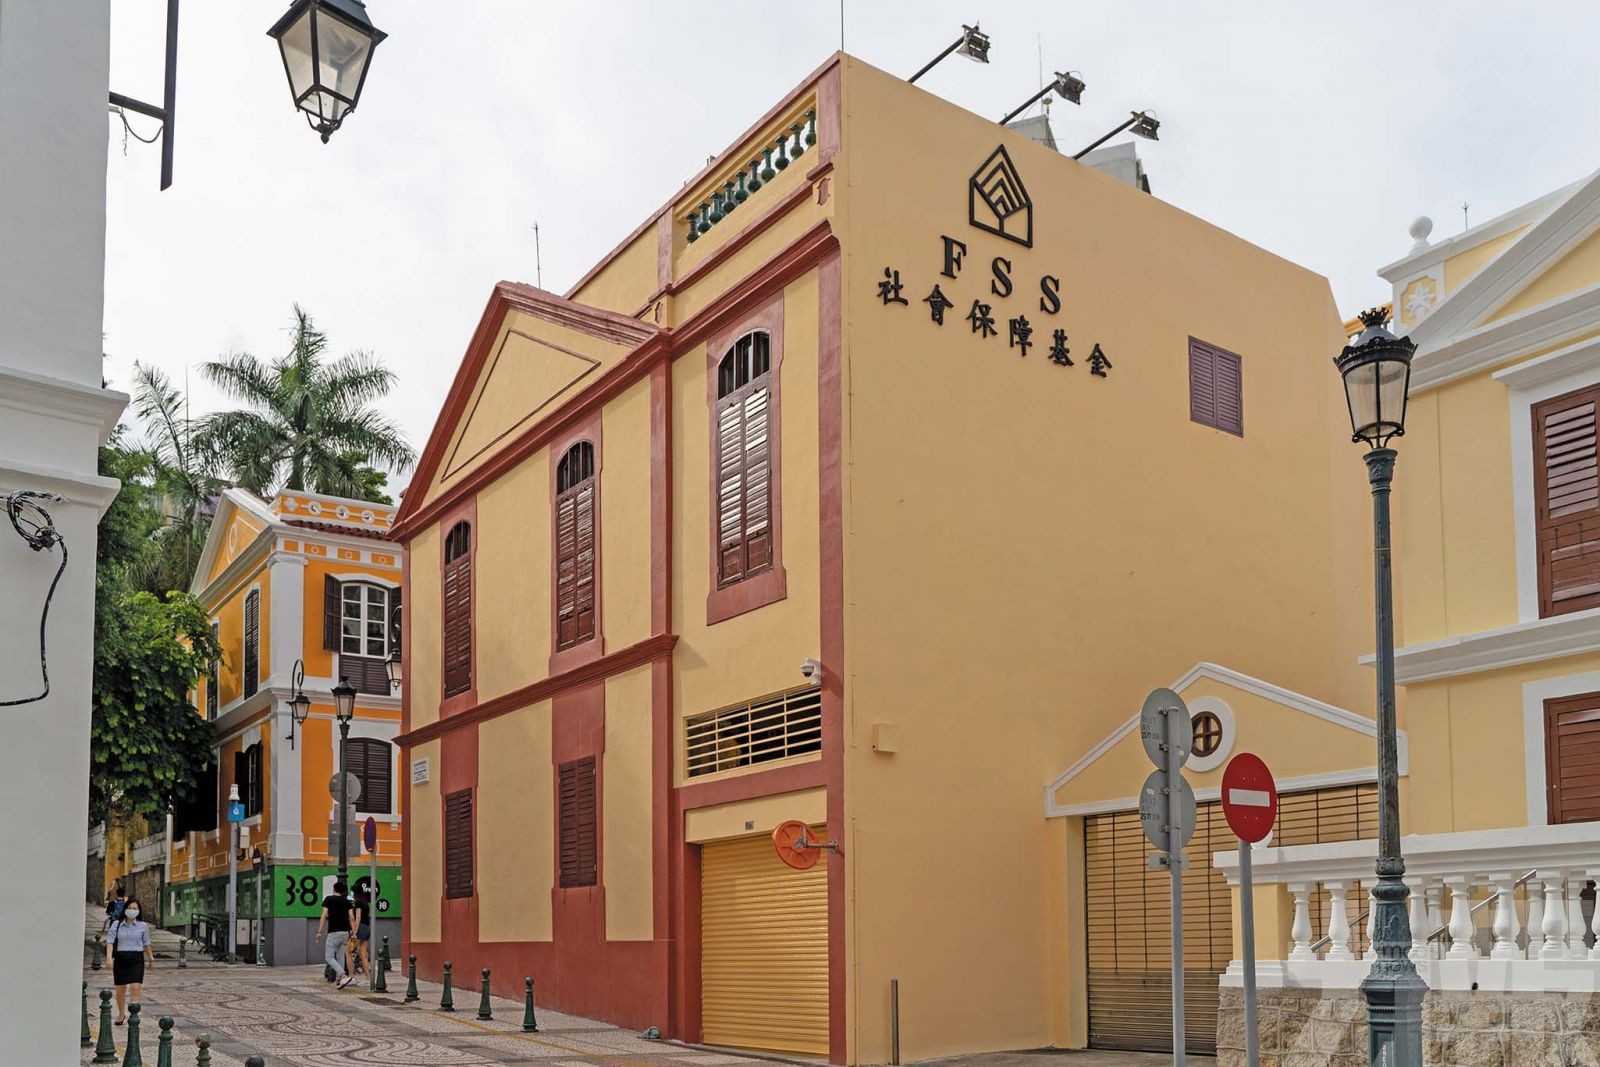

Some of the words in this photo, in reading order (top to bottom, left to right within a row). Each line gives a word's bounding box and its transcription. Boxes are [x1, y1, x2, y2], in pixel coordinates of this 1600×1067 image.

[877, 266, 1113, 378] 社會保障基金
[940, 234, 1061, 315] FSS
